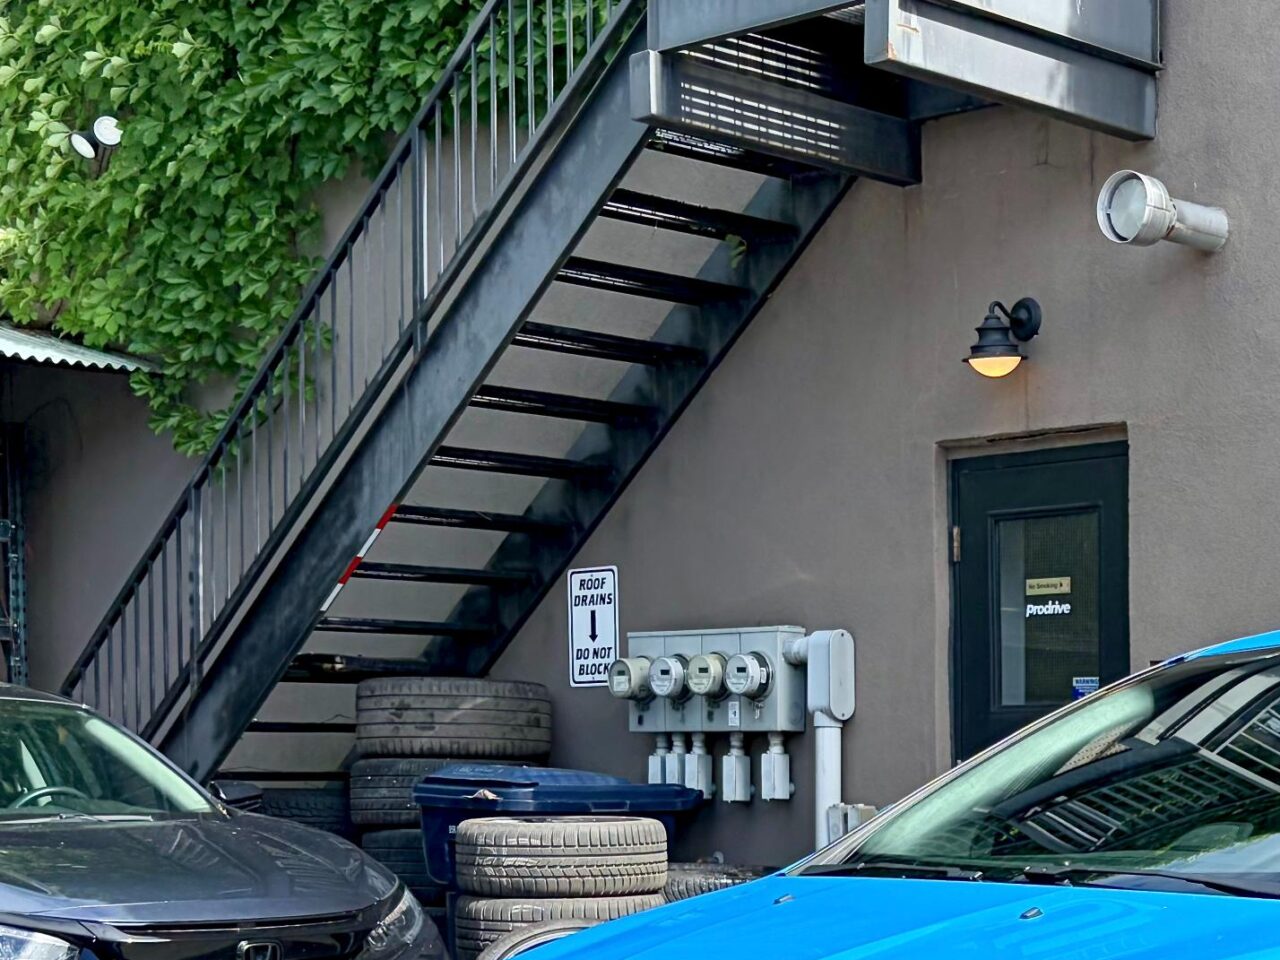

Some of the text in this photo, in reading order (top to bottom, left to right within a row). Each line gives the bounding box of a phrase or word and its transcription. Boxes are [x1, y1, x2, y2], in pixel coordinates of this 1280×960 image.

[579, 577, 607, 591] ROOF
[573, 593, 613, 607] DRAINS
[1026, 600, 1071, 618] prodrive
[576, 646, 613, 660] DO NOT
[578, 662, 610, 676] BLOCK
